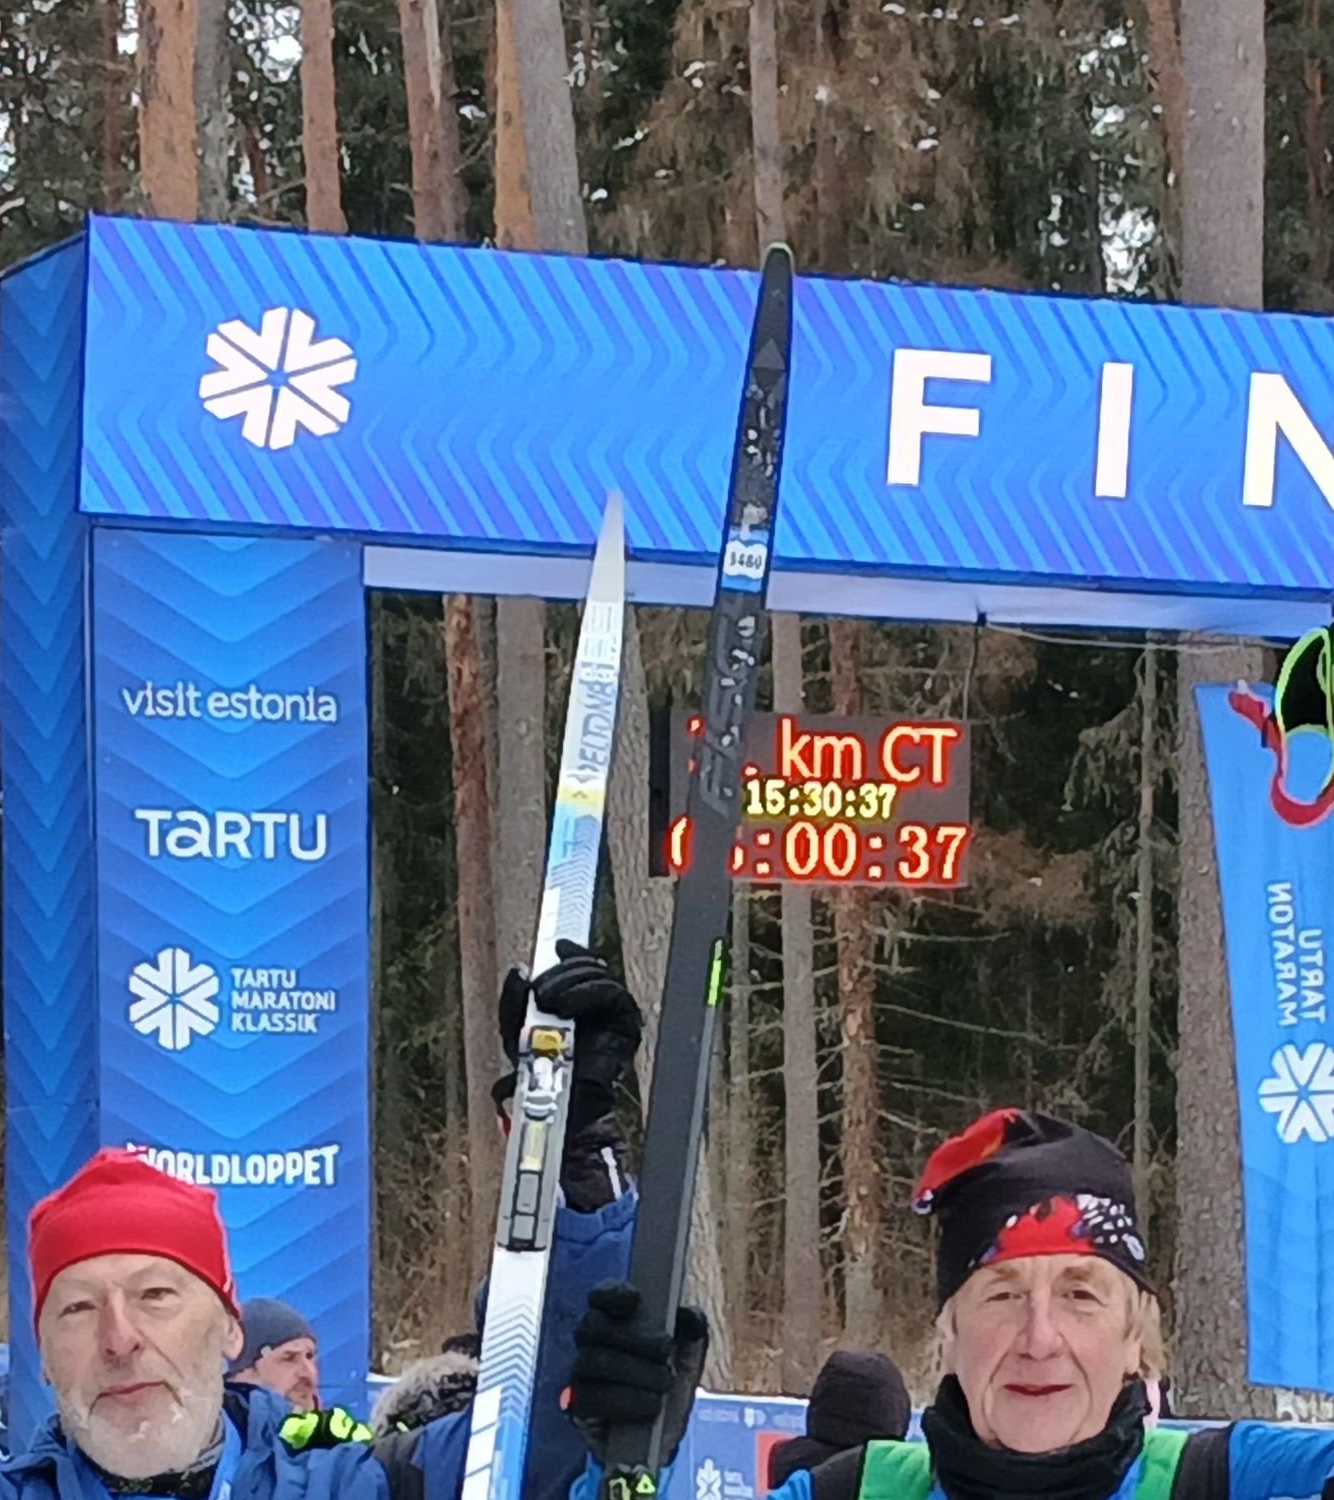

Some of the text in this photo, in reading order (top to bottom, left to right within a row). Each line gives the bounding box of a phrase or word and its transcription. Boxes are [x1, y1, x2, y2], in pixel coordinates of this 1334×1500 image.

[122, 681, 338, 722] visit estonia
[781, 717, 863, 780] km
[882, 725, 958, 783] CT
[746, 780, 898, 819] 15:30:37
[670, 816, 967, 880] :00:37
[231, 967, 296, 989] TARTU
[231, 990, 336, 1012] MARATONI
[231, 1013, 317, 1034] KLASSIK
